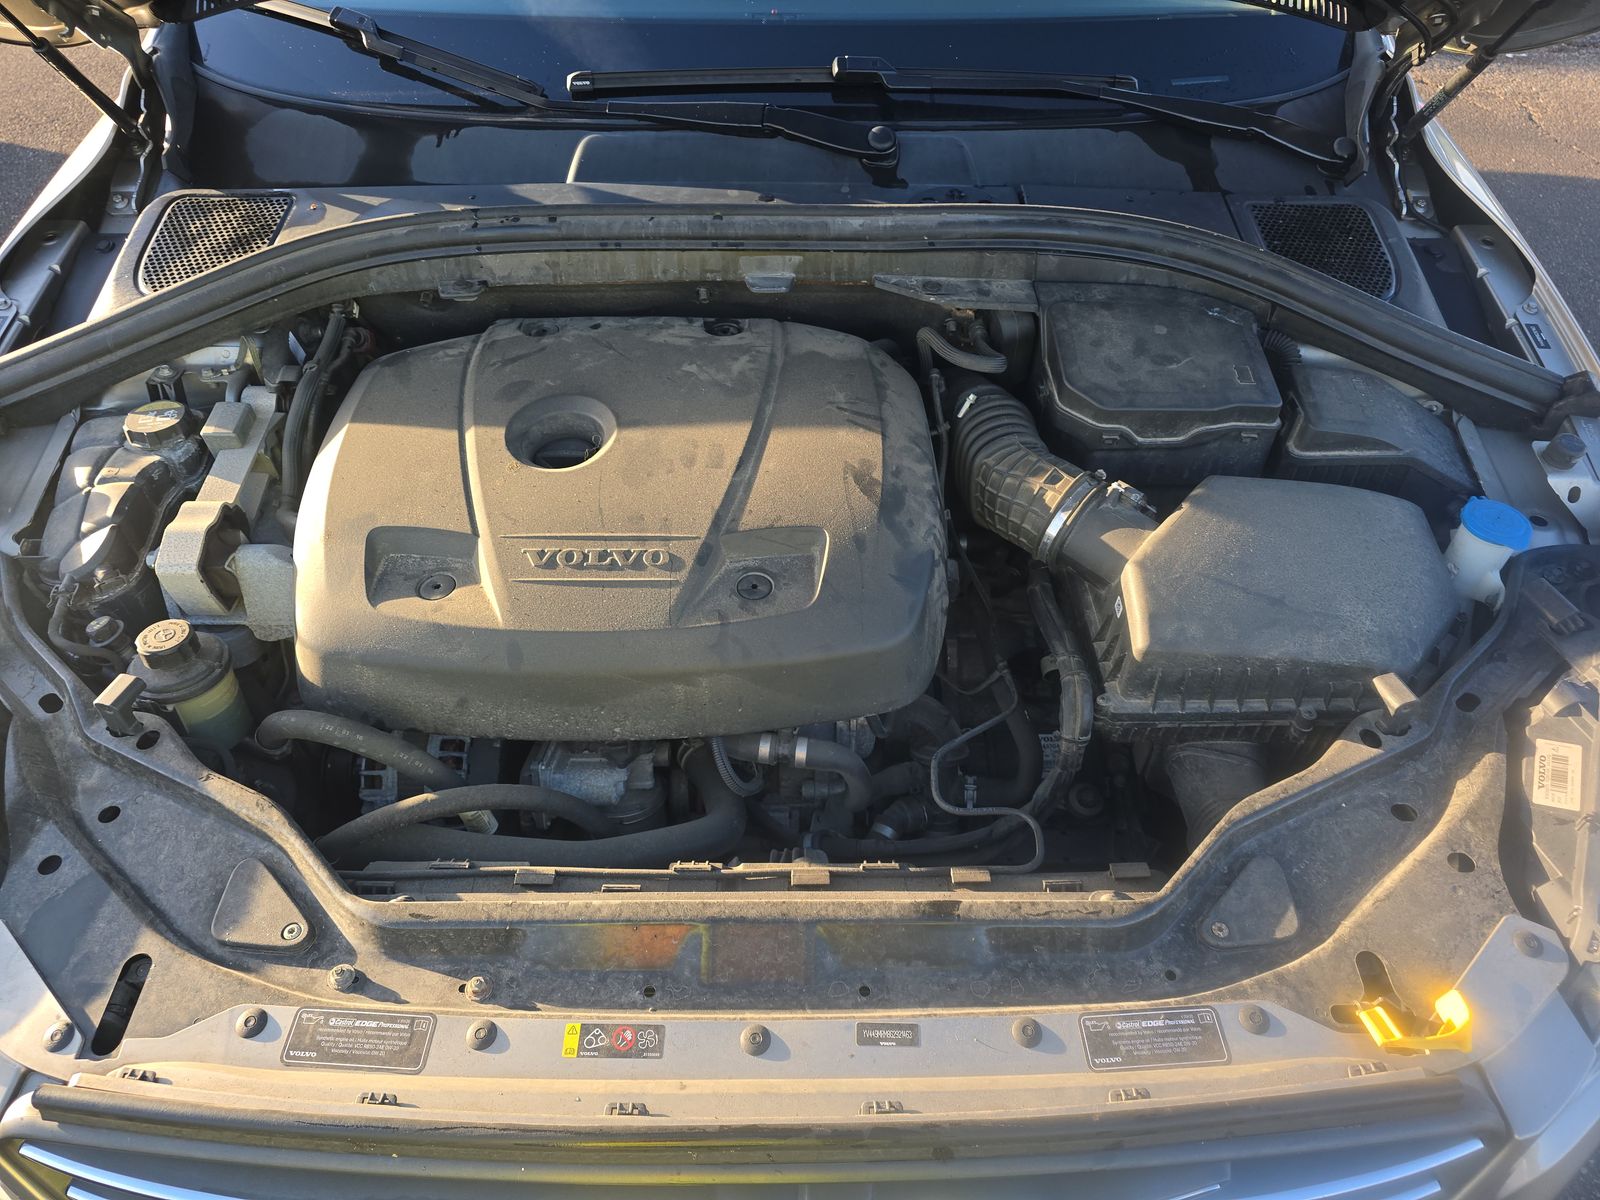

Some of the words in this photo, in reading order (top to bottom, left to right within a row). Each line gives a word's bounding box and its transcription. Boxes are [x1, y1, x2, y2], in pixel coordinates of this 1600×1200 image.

[520, 548, 670, 568] VOLVO
[1537, 755, 1547, 790] VOLVO
[354, 1020, 380, 1028] EDGE
[1141, 1019, 1165, 1027] EDGE
[288, 1050, 317, 1058] VOLVO
[1094, 1056, 1122, 1064] VOLVO
